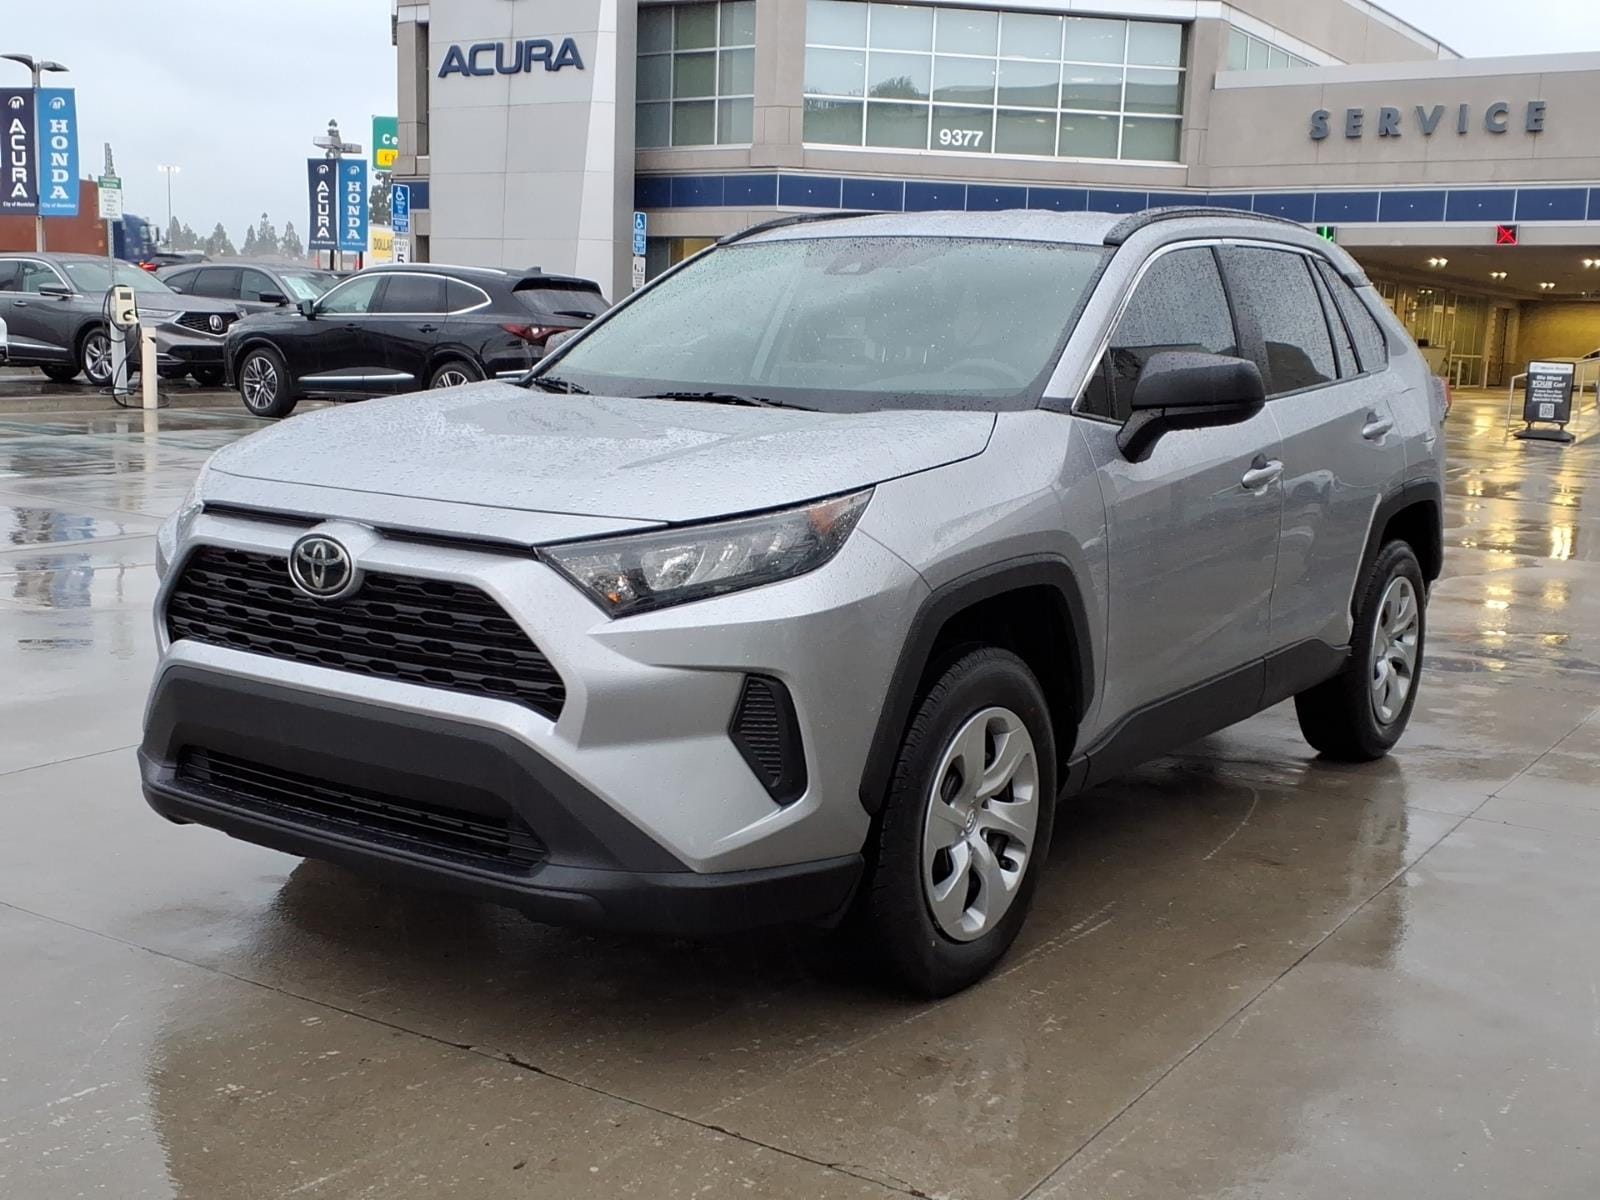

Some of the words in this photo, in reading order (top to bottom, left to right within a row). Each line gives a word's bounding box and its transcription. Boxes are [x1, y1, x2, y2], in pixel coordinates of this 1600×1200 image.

[438, 37, 584, 77] ACURA
[939, 128, 984, 148] 9377
[1309, 101, 1547, 140] SERVICE
[9, 118, 28, 198] ACURA
[49, 119, 69, 200] HONDA
[316, 180, 330, 238] ACURA
[346, 181, 361, 240] HONDA
[397, 253, 405, 263] 5
[1532, 380, 1553, 388] YOUR
